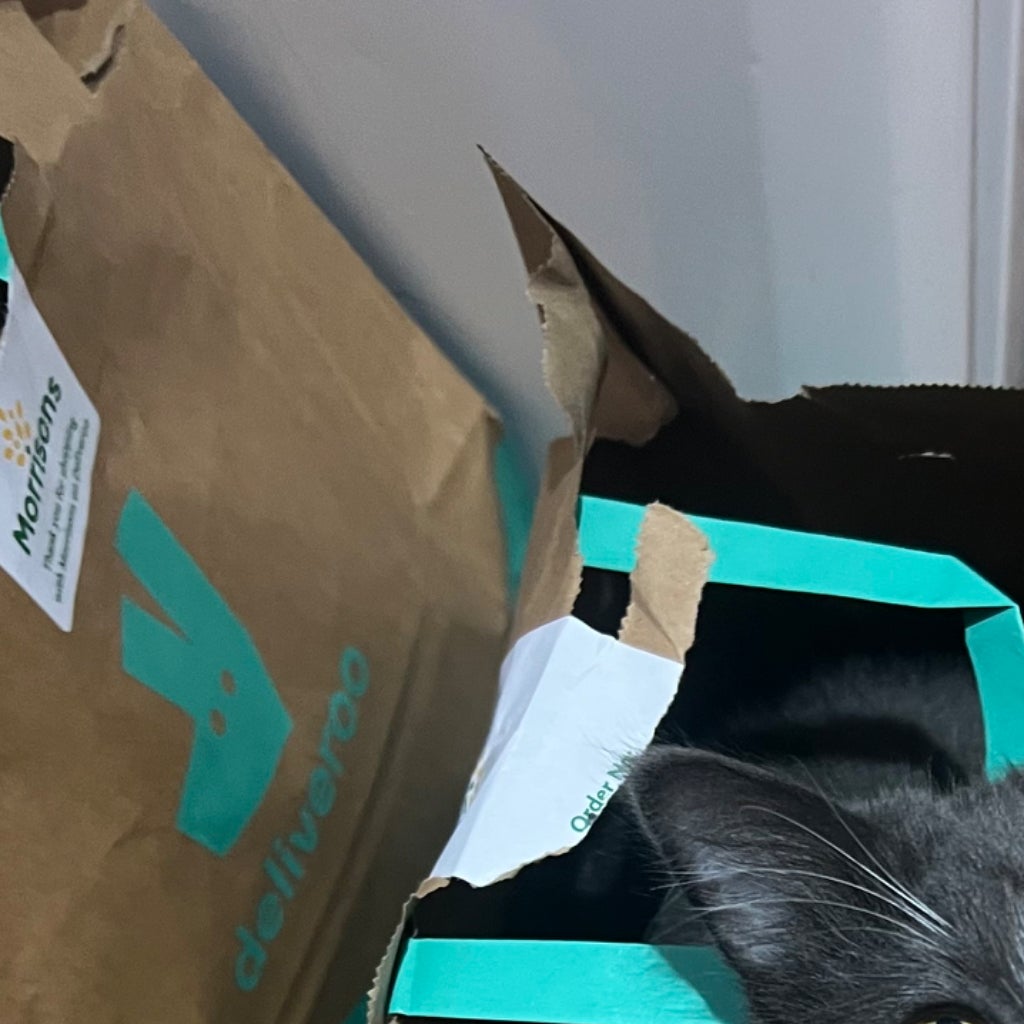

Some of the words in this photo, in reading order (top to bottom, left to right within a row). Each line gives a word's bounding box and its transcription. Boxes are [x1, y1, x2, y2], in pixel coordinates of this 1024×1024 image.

[13, 376, 63, 555] Morrisons
[235, 646, 370, 991] deliveroo
[569, 780, 614, 833] Order
